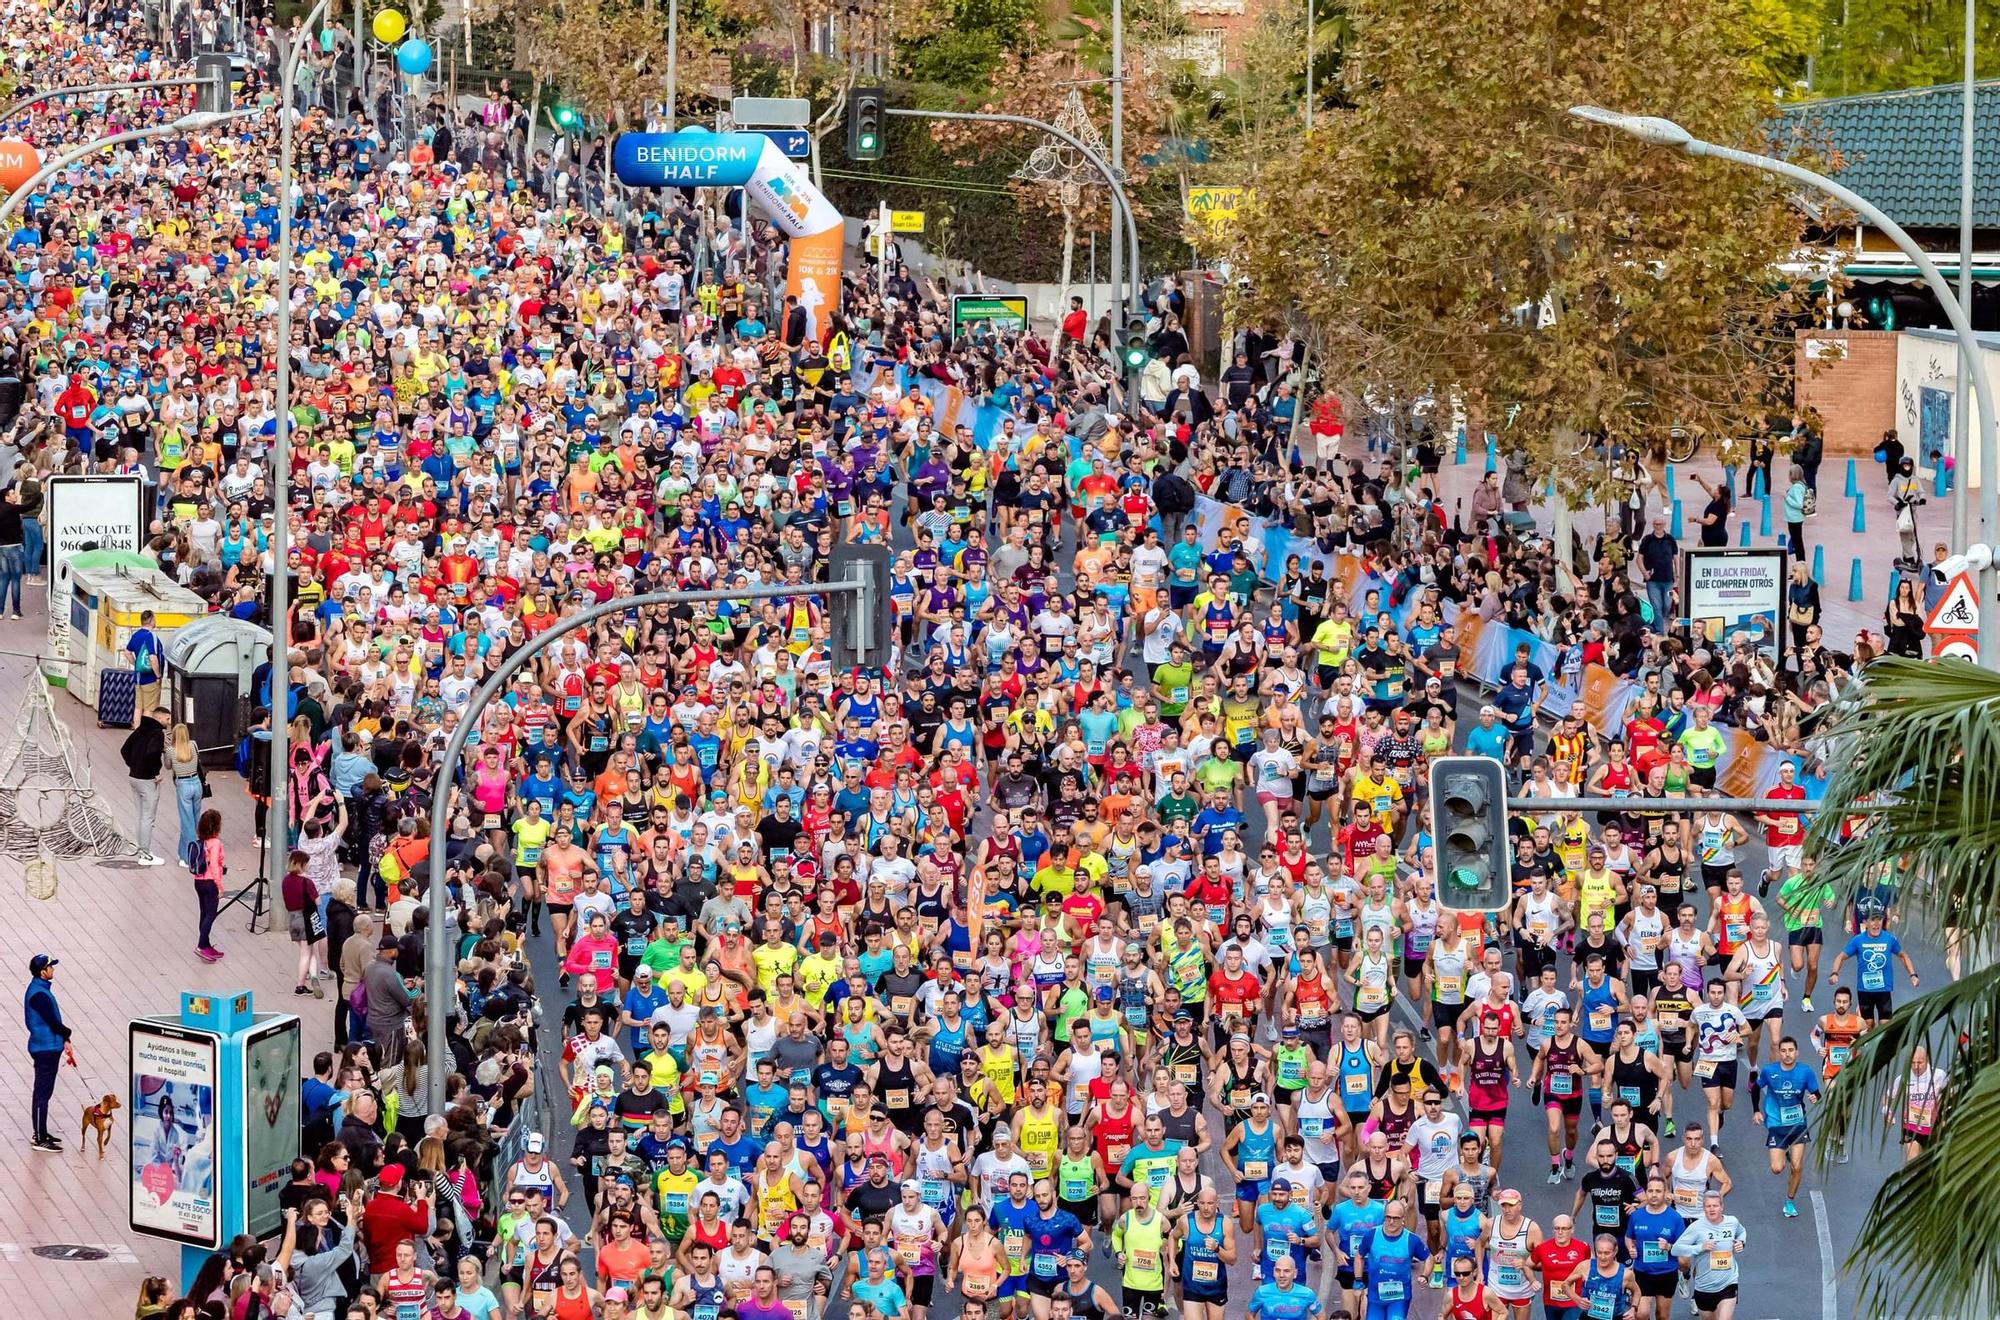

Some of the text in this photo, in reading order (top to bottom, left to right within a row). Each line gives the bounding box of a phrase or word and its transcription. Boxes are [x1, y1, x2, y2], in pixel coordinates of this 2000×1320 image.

[637, 147, 746, 162] BENIDORM
[663, 165, 718, 179] HALF
[755, 179, 805, 231] BENIDORM HALF
[61, 522, 132, 535] ANÚNCIATE
[61, 541, 81, 551] 966
[111, 539, 132, 550] 848
[1702, 568, 1767, 578] EN BLACK FRIDAY,
[1695, 578, 1774, 589] QUE COMPREN OTROS
[147, 1042, 175, 1054] Ayúdanos
[139, 1051, 158, 1061] mucho
[158, 1055, 170, 1063] más
[171, 1058, 182, 1066] que
[164, 1067, 187, 1077] hospital
[1591, 1188, 1622, 1197] Filipides
[1722, 1230, 1732, 1238] 22
